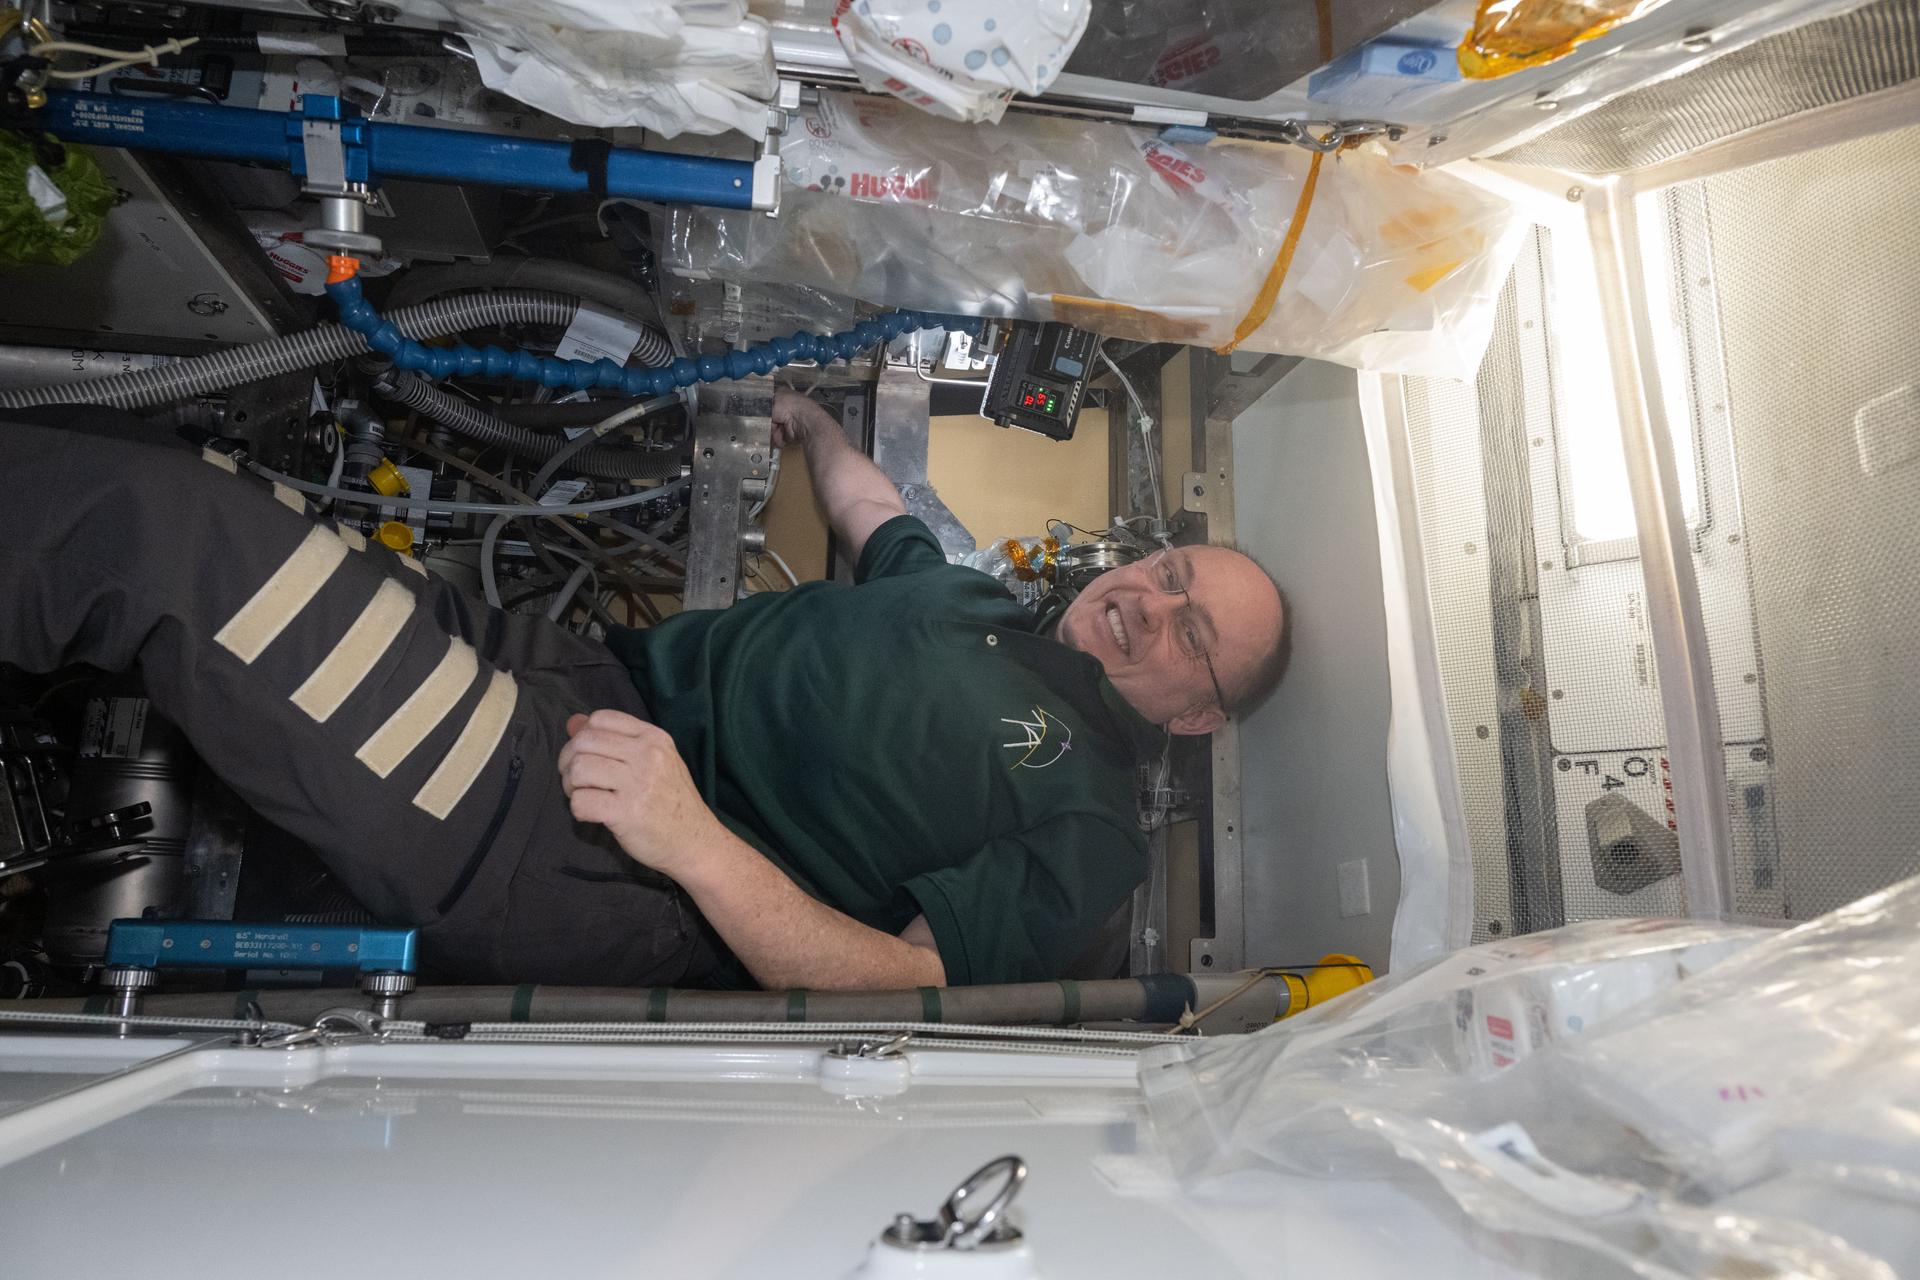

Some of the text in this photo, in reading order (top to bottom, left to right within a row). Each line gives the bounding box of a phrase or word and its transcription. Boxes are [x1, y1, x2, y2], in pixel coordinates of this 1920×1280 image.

[1064, 328, 1074, 349] Canon
[1036, 392, 1047, 406] 59
[1575, 760, 1599, 775] F
[1602, 775, 1625, 791] 4
